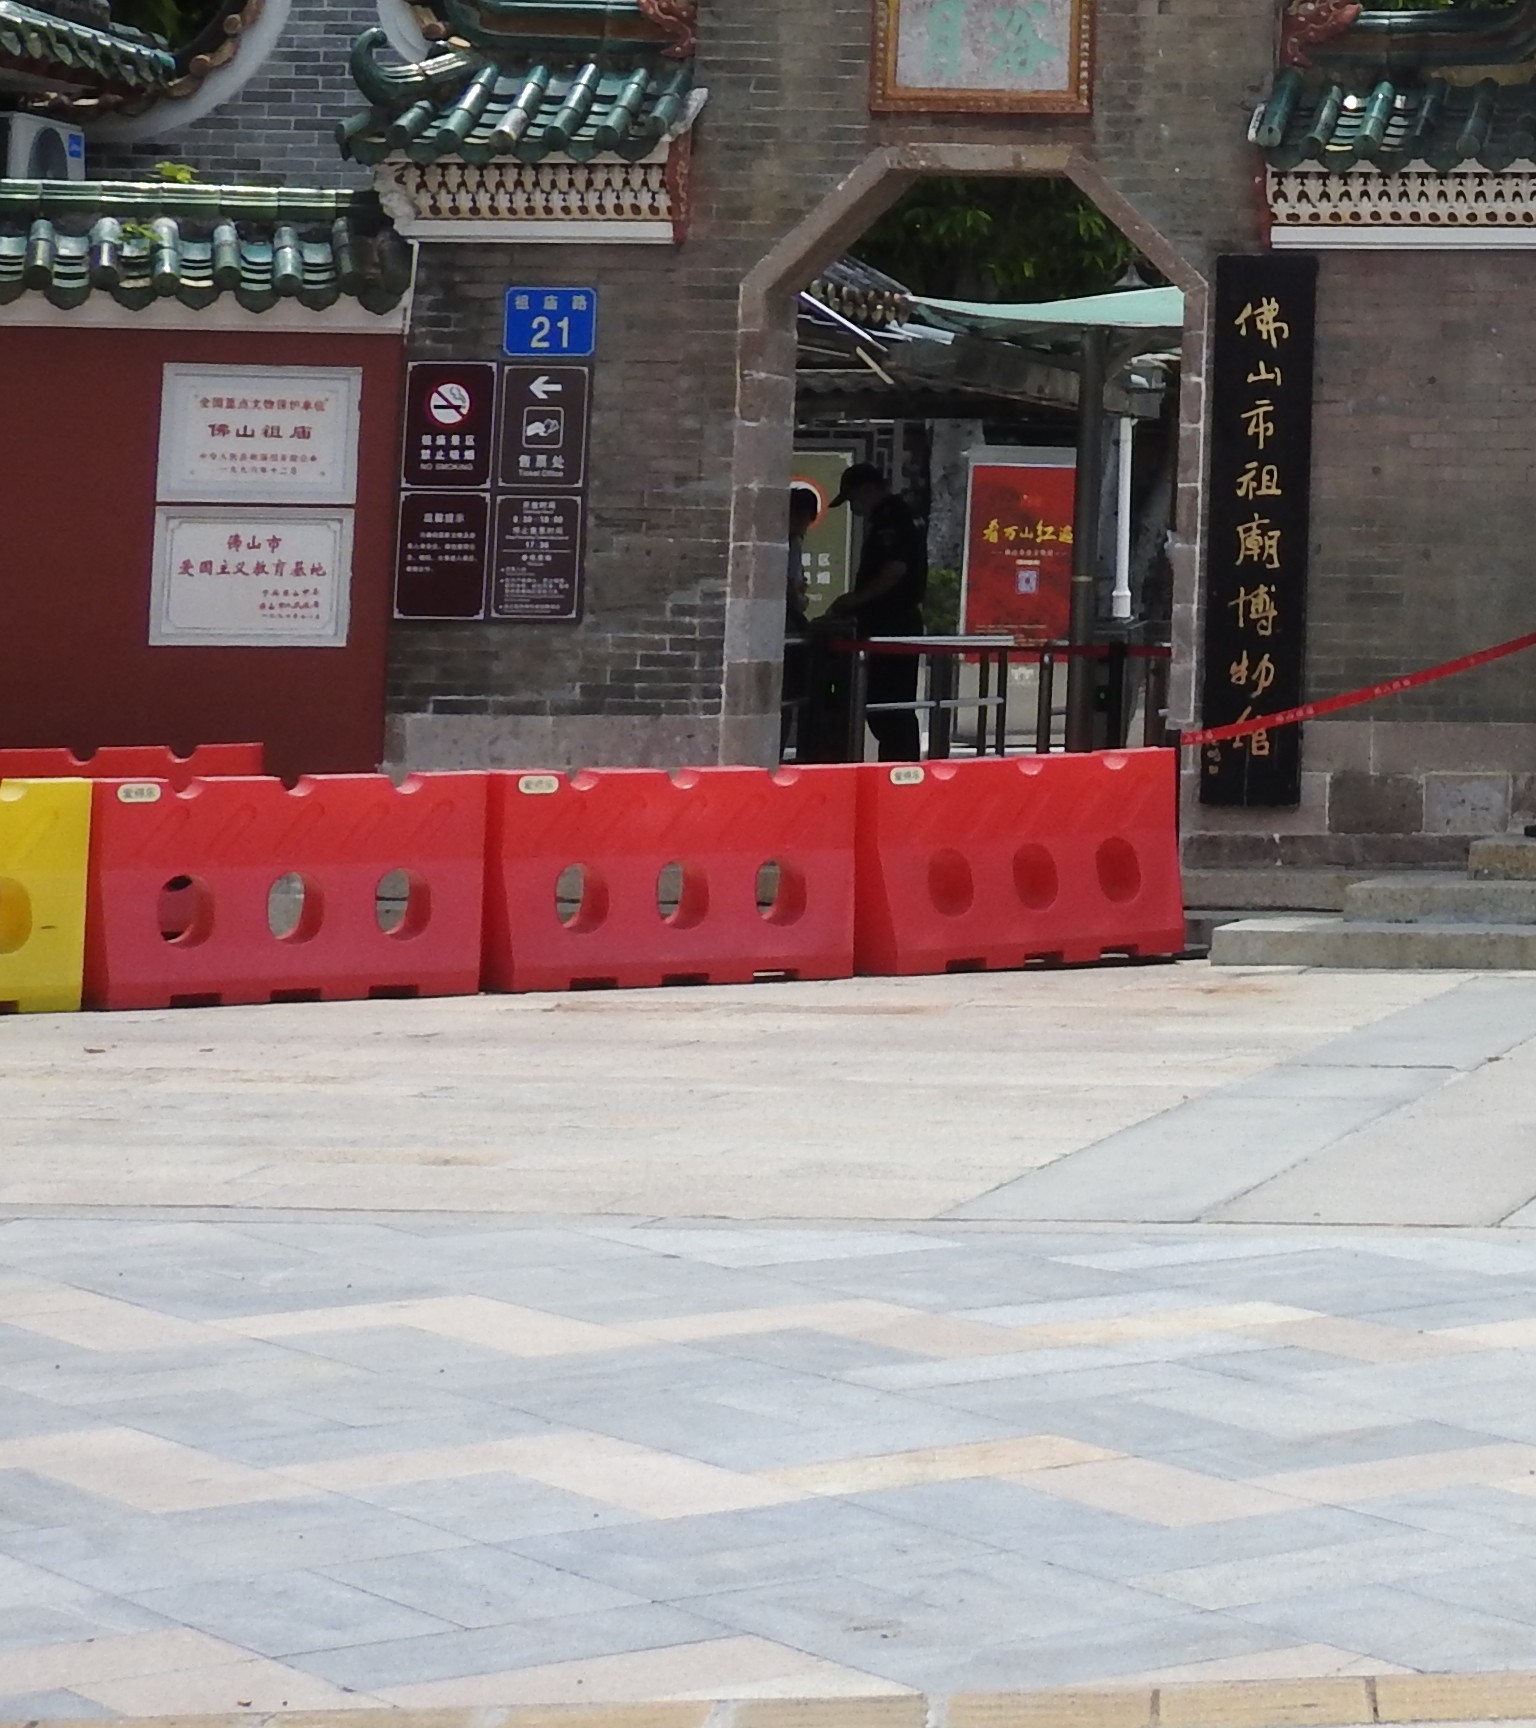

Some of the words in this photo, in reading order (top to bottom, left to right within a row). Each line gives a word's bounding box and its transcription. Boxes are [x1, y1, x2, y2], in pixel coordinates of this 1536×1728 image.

[515, 294, 587, 311] 祖庙路
[530, 316, 569, 349] 21
[208, 423, 312, 440] 佛山祖庙
[227, 532, 282, 553] 佛山市
[178, 558, 327, 577] 爱国主义教育基地
